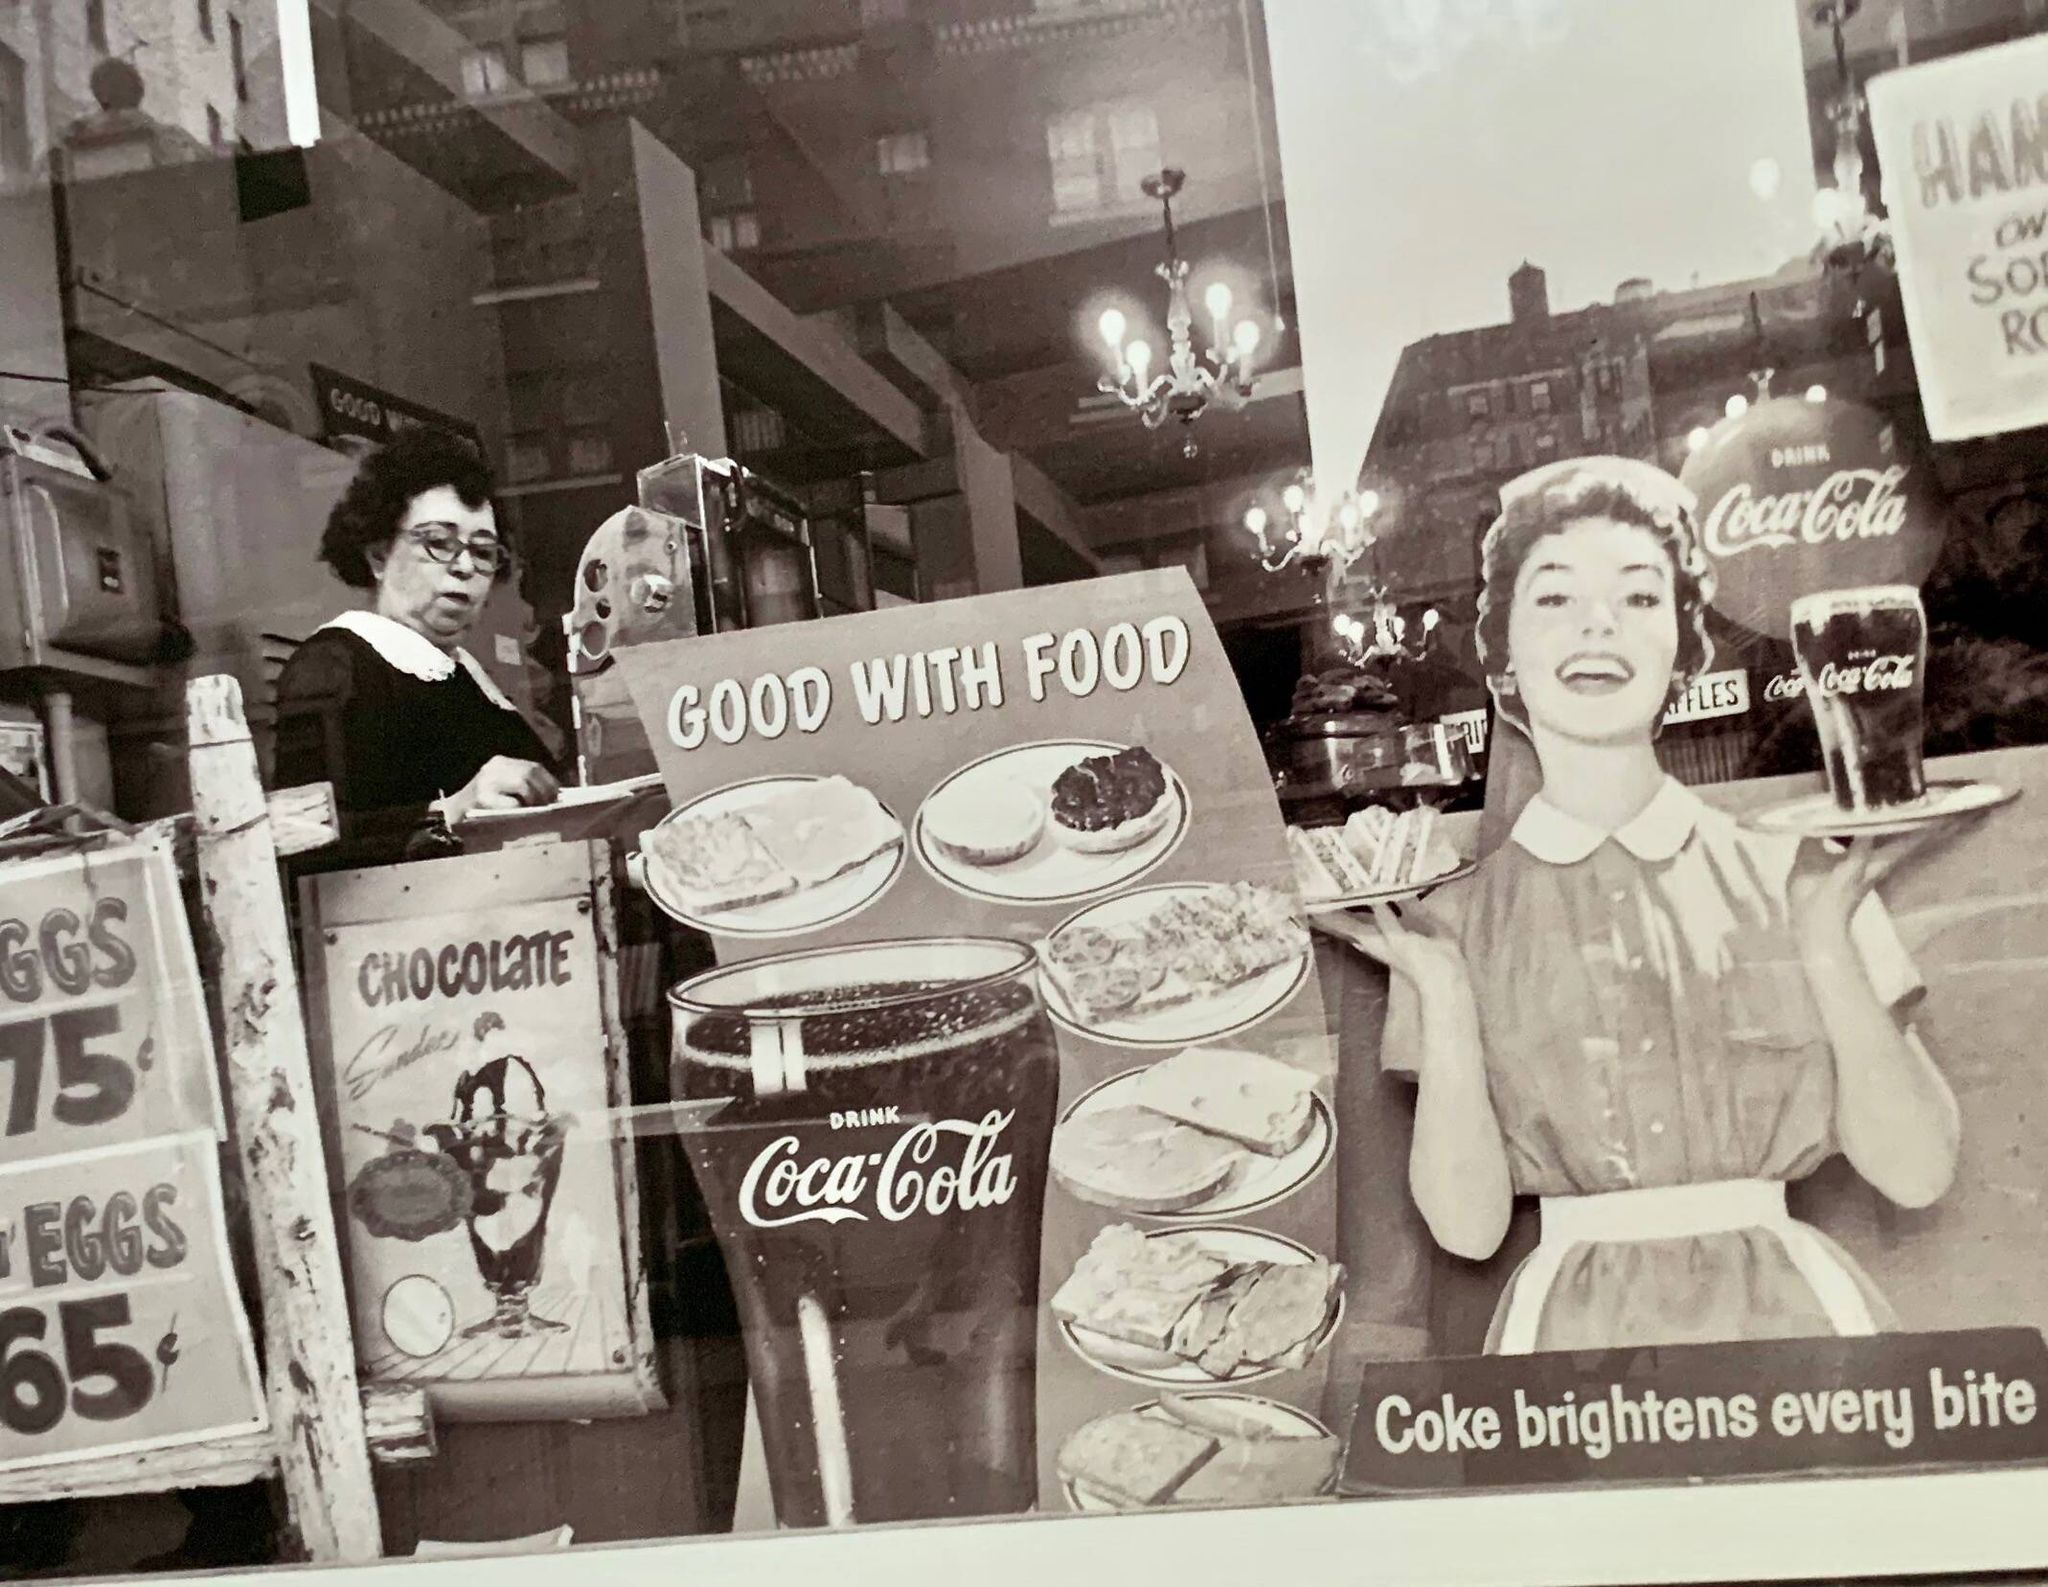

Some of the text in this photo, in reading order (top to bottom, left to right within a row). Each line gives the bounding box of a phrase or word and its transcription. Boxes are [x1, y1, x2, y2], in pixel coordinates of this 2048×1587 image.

[1704, 464, 1910, 556] Coca-Cola
[667, 616, 1190, 750] GOOD WITH FOOD
[829, 1105, 900, 1130] DRINK
[738, 1108, 1018, 1228] Coca-Cola
[24, 1183, 187, 1288] EGGS
[1375, 1368, 2037, 1459] Coke brightens every bite
